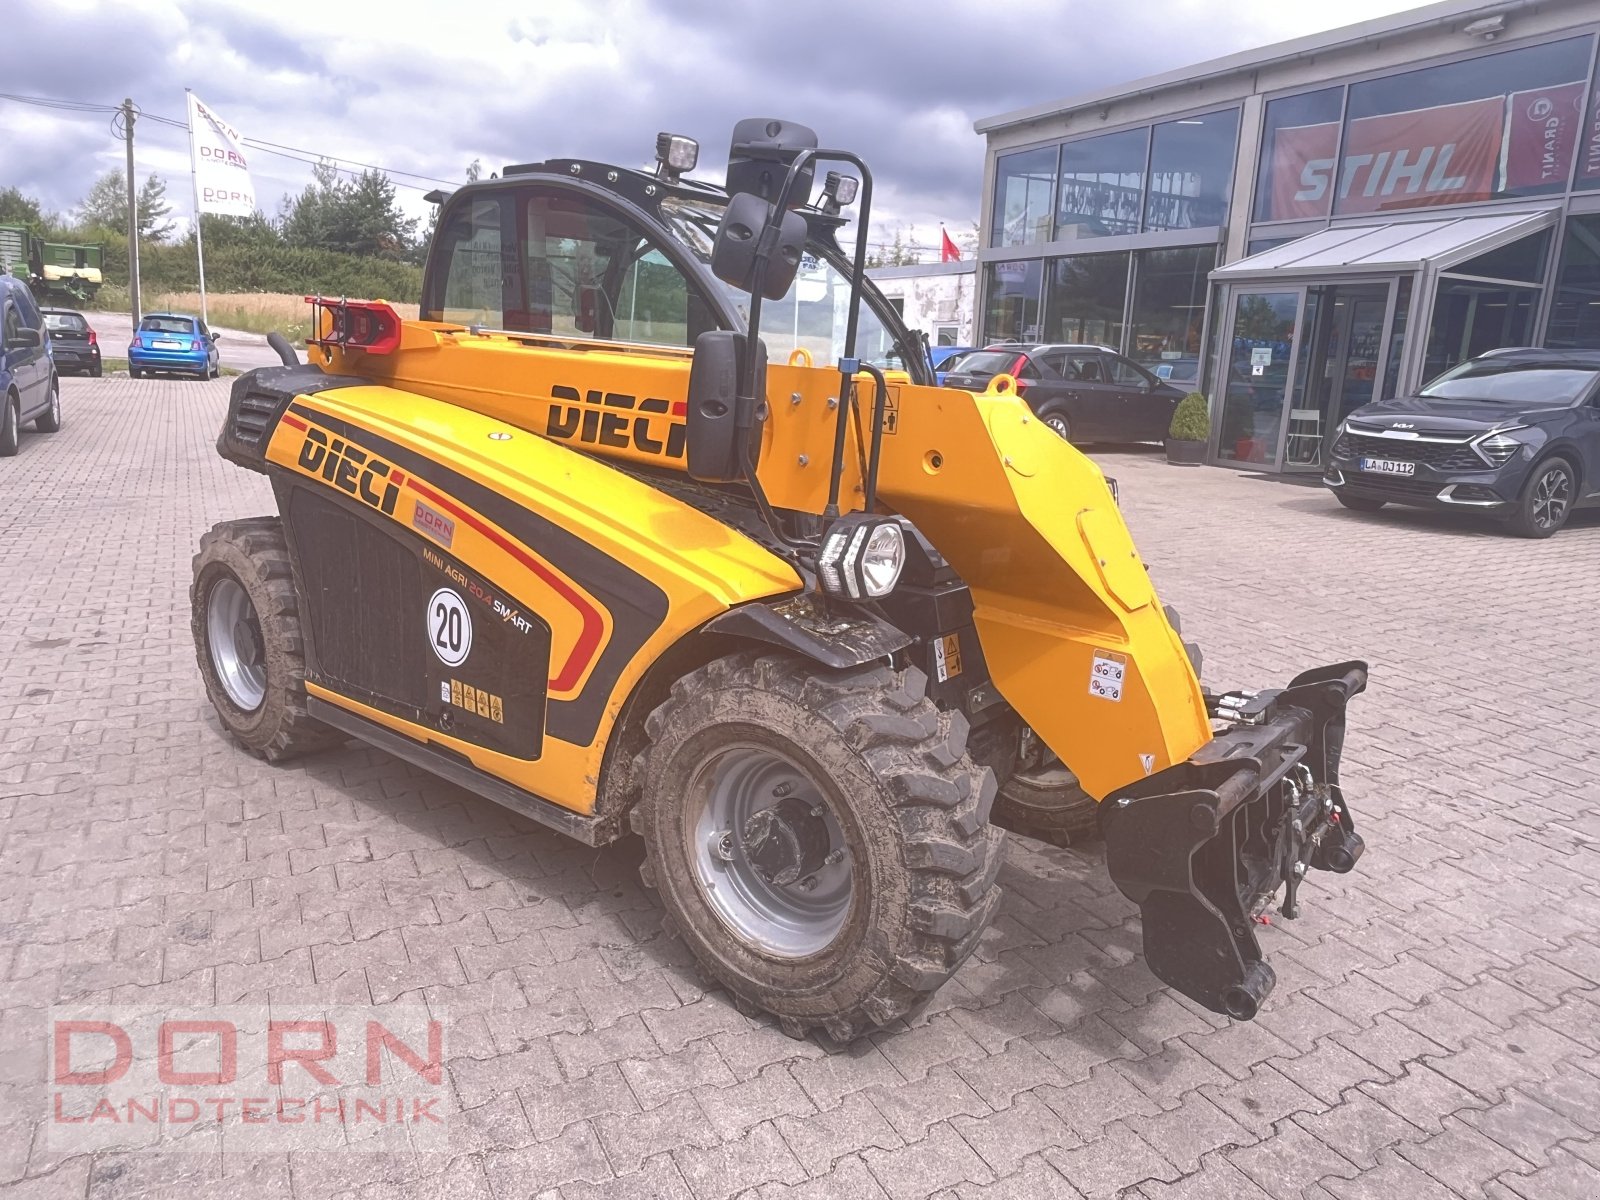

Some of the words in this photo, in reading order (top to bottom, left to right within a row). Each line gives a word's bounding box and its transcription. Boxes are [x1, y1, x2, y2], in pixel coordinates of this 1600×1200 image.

[200, 146, 247, 167] DORN
[1294, 144, 1466, 201] STIHL
[203, 187, 254, 205] DORN
[546, 384, 688, 459] DIECI
[298, 427, 406, 516] DIECI
[1365, 460, 1377, 470] LA
[415, 505, 452, 537] DORN
[423, 548, 443, 570] MINI
[444, 564, 468, 588] AGRI
[493, 599, 533, 634] SMART
[436, 602, 462, 652] 20
